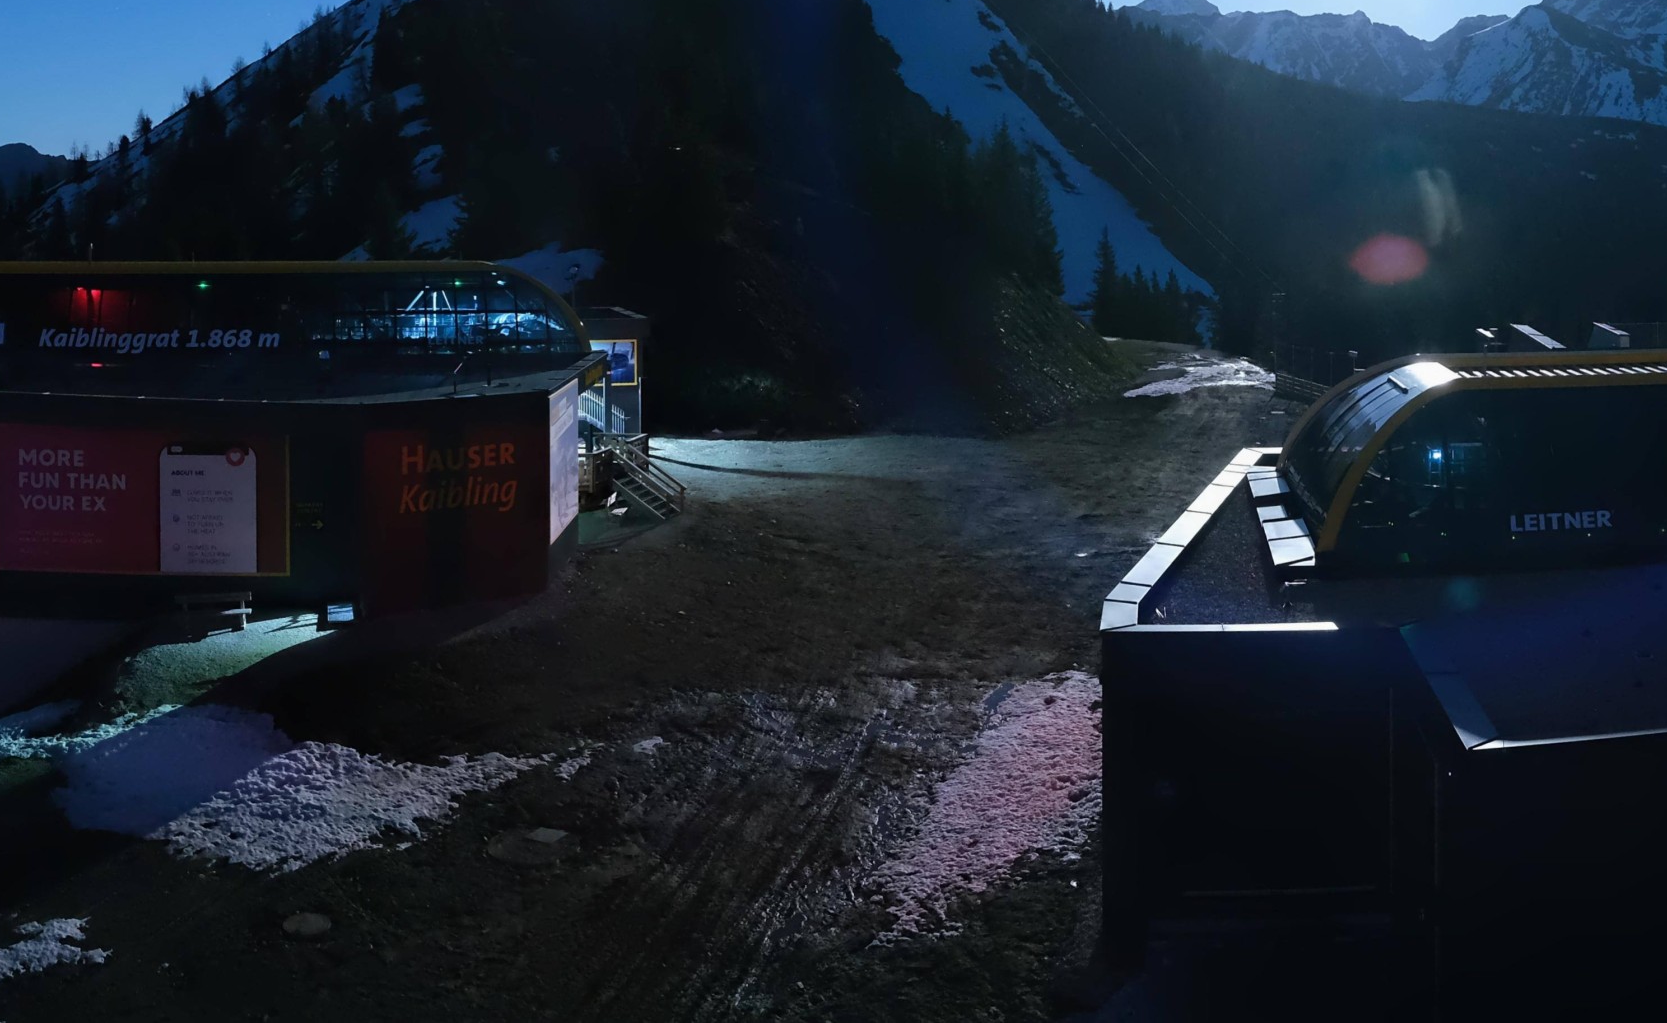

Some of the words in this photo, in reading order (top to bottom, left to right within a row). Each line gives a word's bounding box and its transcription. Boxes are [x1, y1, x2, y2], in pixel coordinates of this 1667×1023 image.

[38, 327, 179, 354] Kaiblinggrat
[186, 328, 251, 349] 1.868
[257, 332, 281, 348] m
[427, 335, 484, 345] LEITNER
[18, 448, 85, 468] MORE
[18, 472, 60, 489] FUN
[66, 473, 127, 491] THAN
[19, 494, 75, 511] YOUR
[81, 495, 107, 512] EX
[399, 477, 518, 514] Kaibling
[1510, 510, 1613, 532] LEITNER
